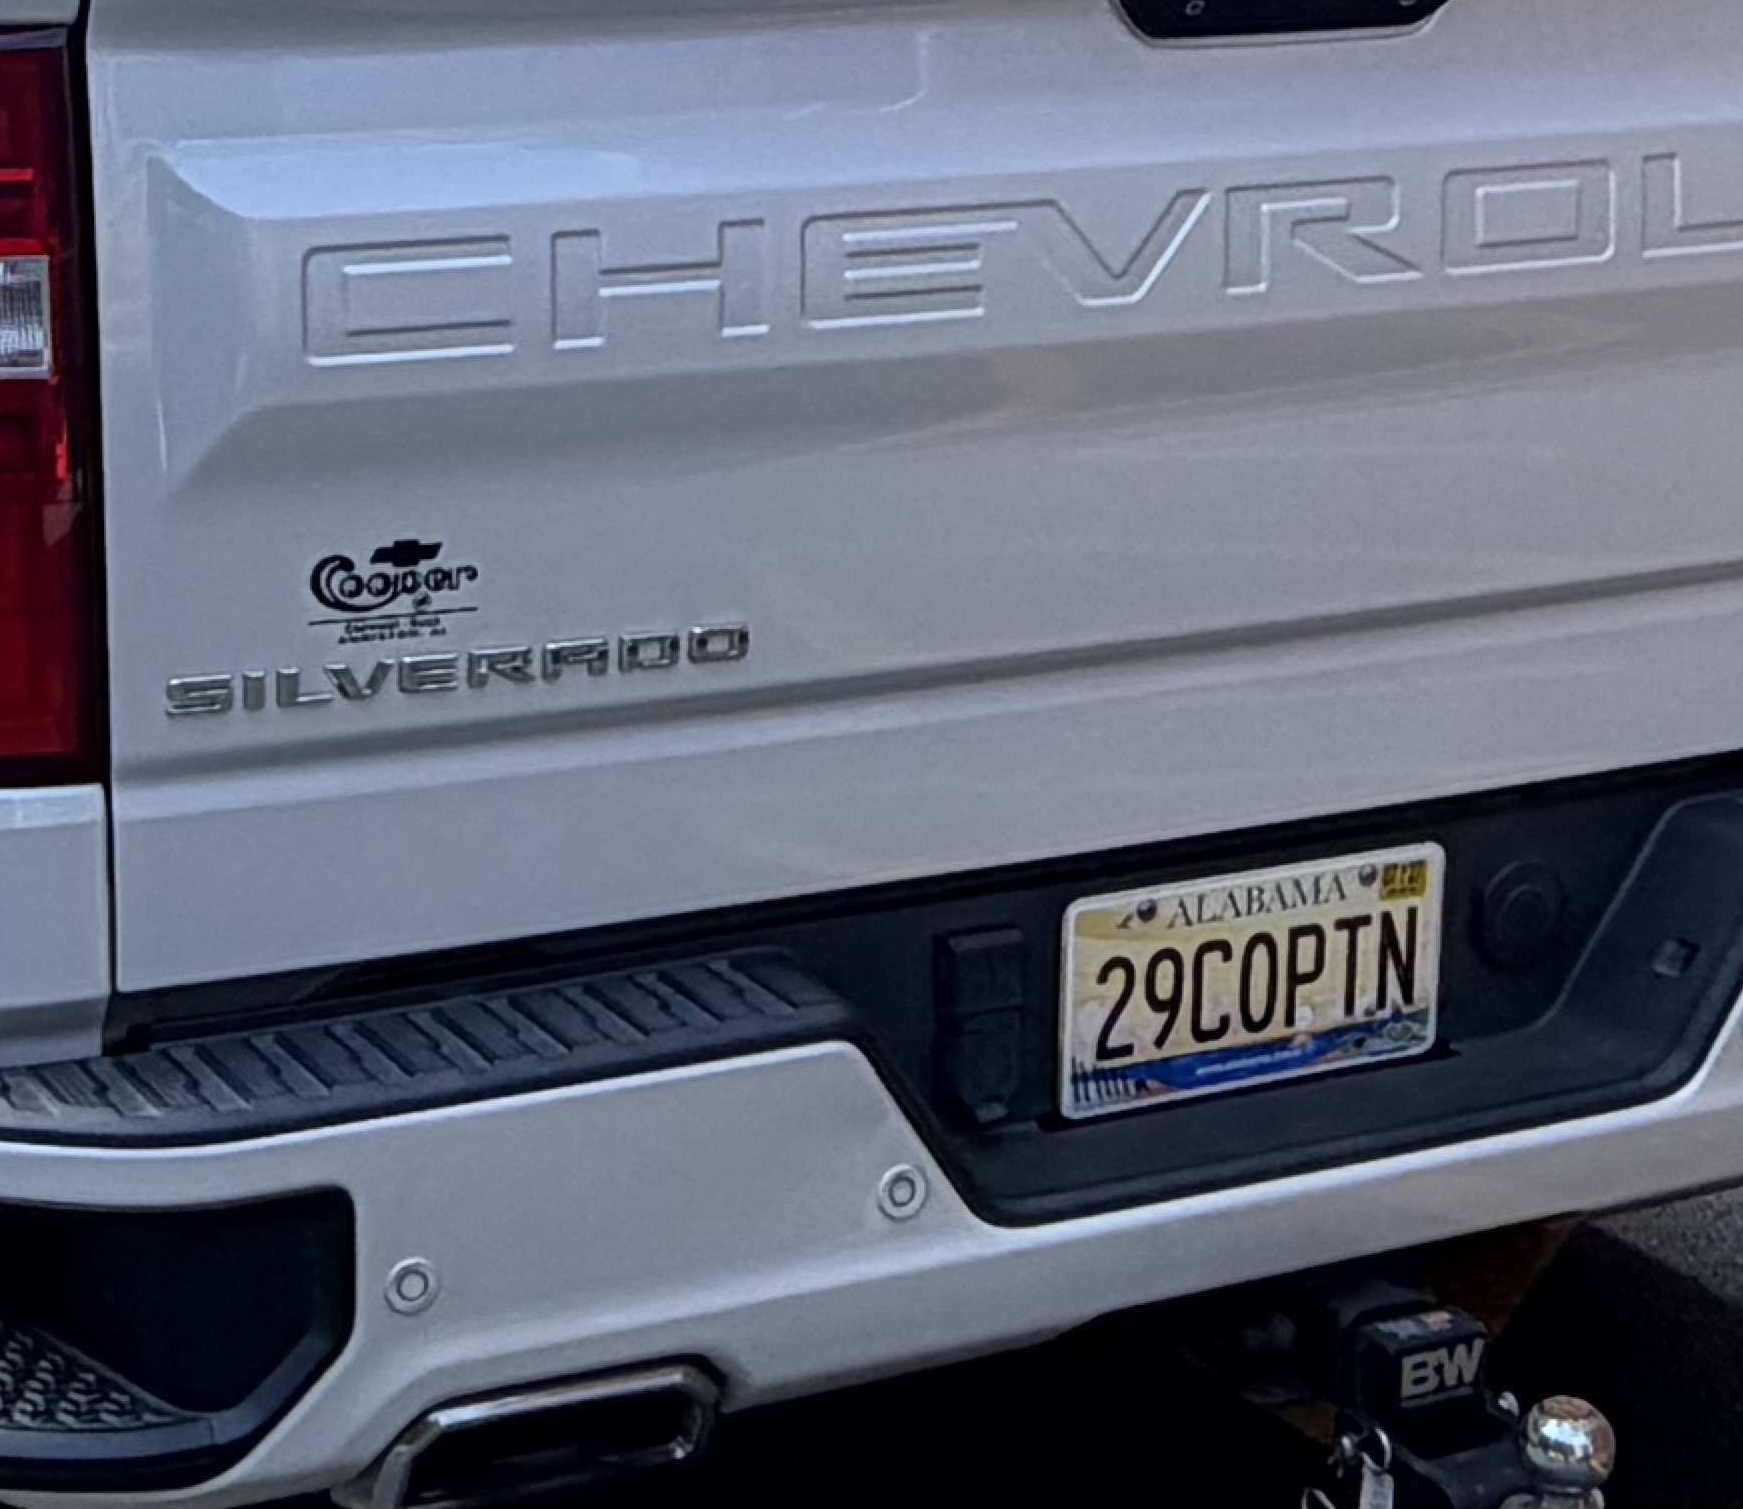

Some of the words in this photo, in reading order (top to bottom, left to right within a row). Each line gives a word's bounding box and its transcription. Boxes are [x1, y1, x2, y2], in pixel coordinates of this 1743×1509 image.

[309, 554, 479, 614] Cooper
[164, 622, 751, 718] SILVERADO
[1166, 872, 1347, 930] ALABAMA
